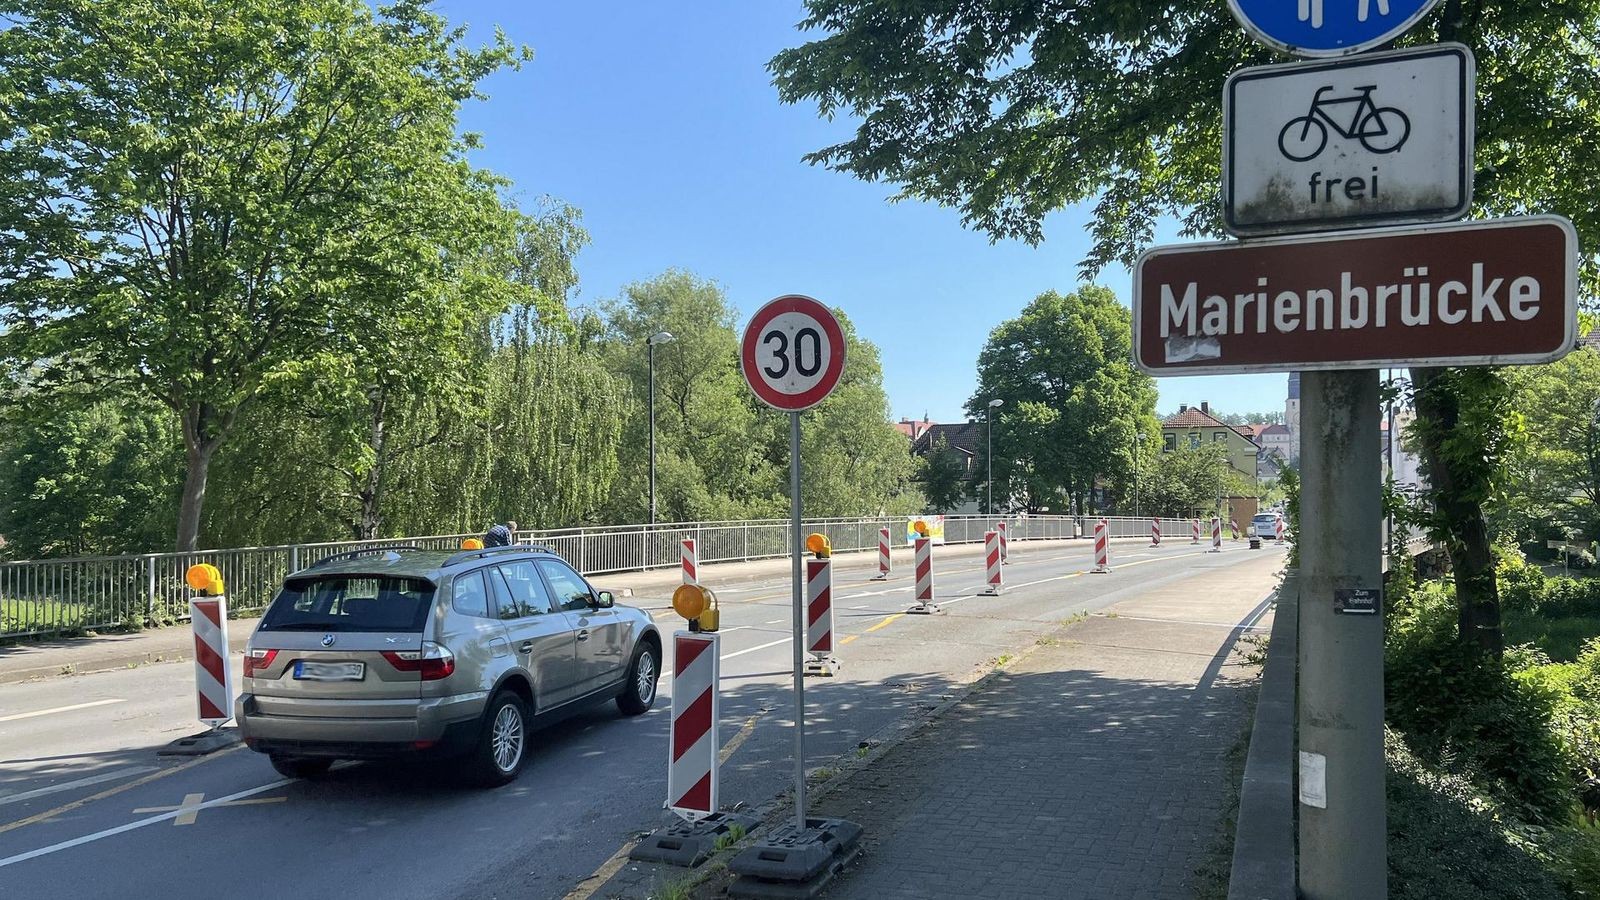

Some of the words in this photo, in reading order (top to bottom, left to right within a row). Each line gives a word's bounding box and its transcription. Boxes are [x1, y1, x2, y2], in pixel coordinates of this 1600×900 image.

[1309, 167, 1379, 203] frei
[1160, 263, 1541, 338] Marienbrücke
[763, 327, 822, 379] 30
